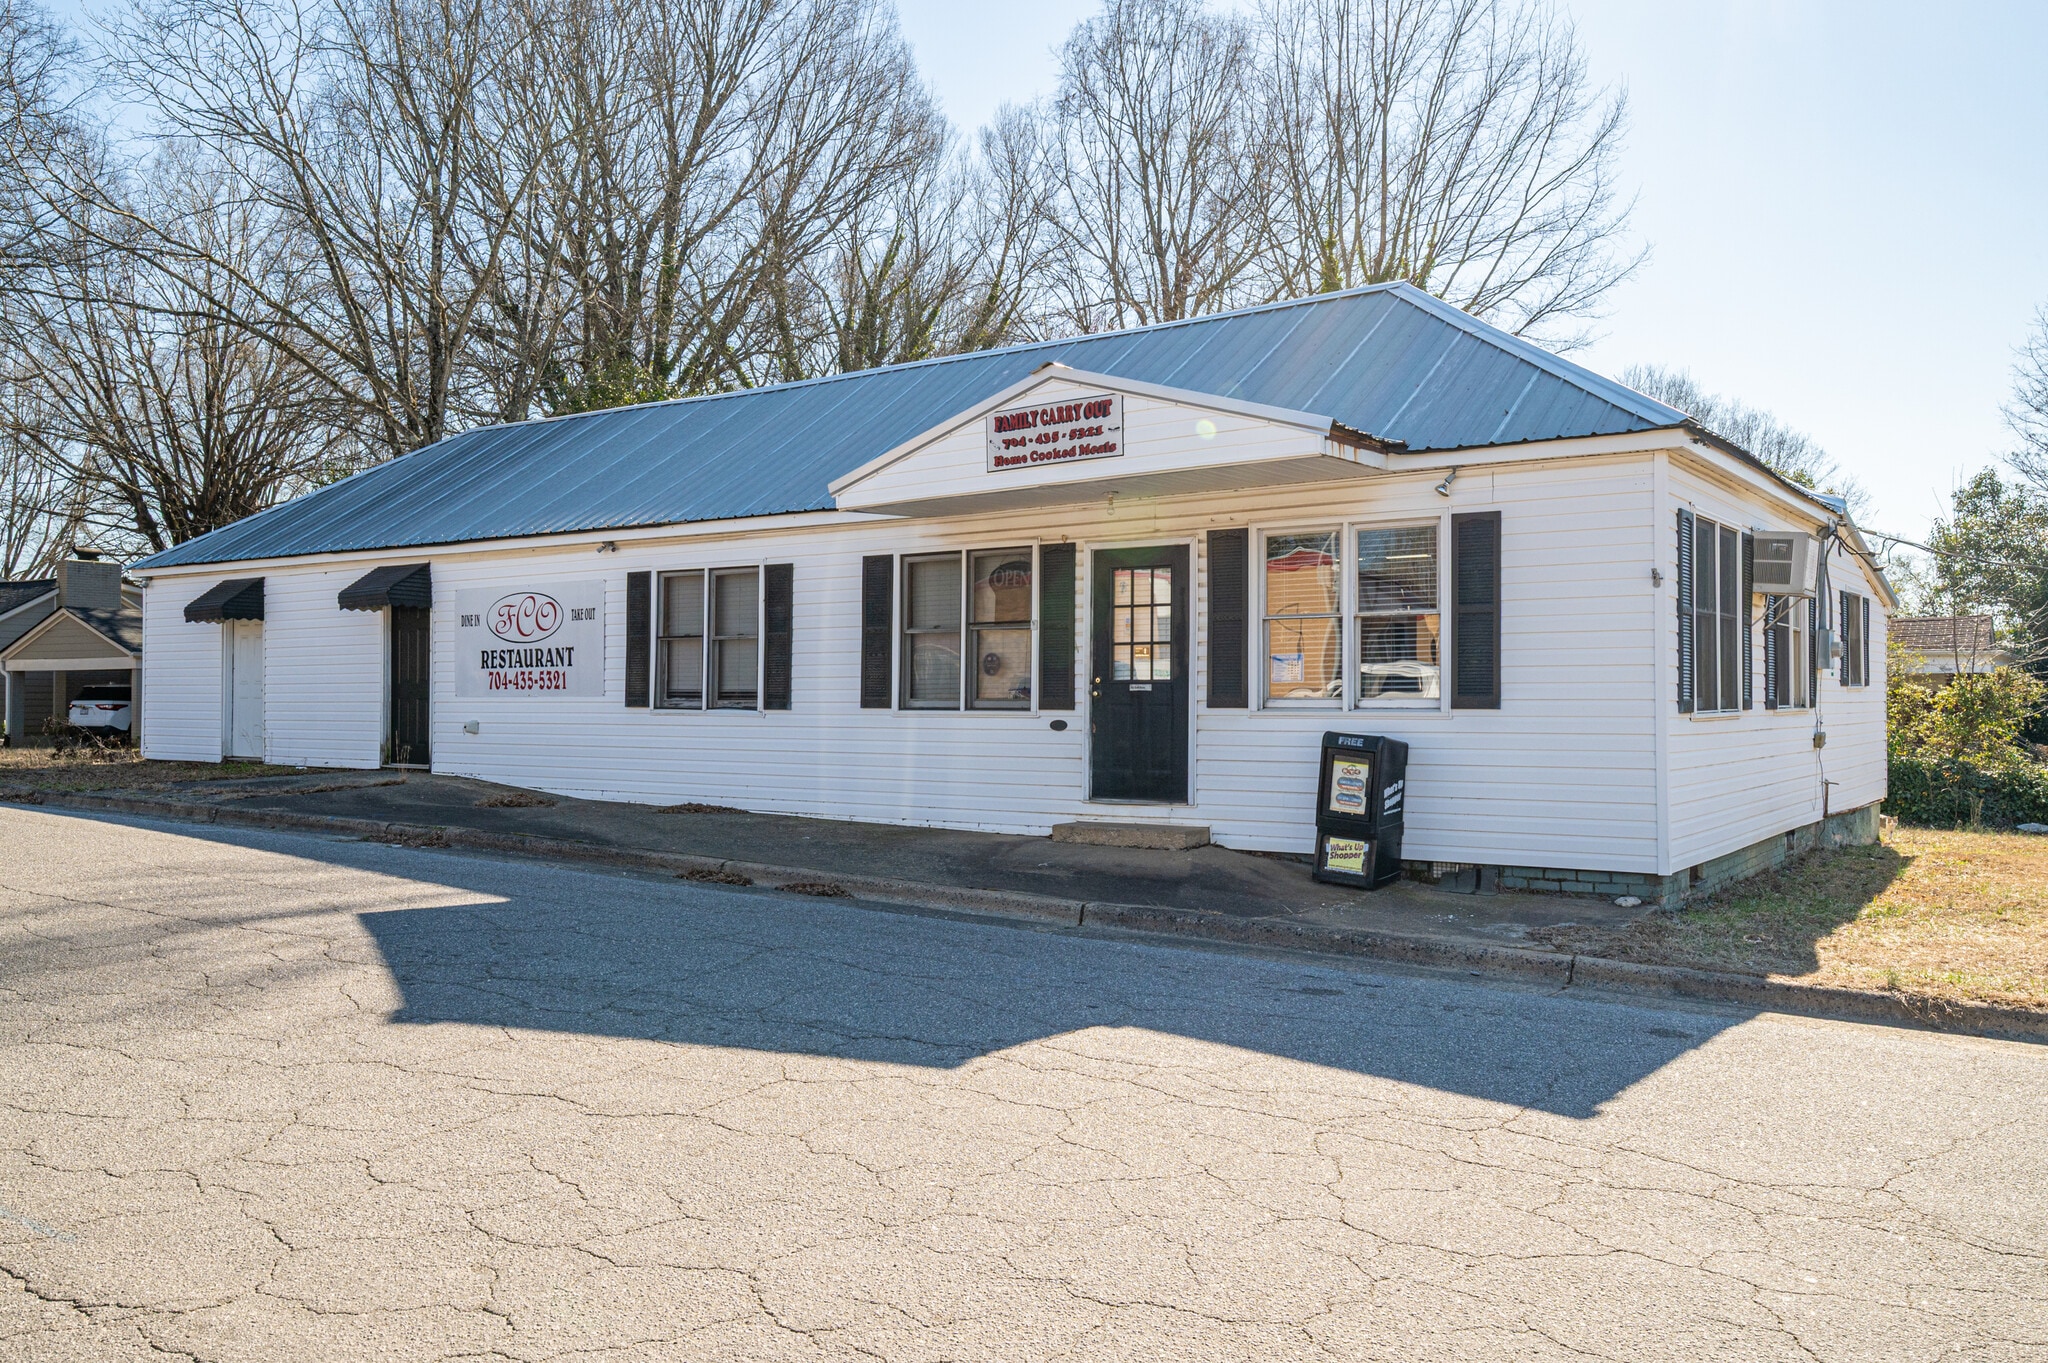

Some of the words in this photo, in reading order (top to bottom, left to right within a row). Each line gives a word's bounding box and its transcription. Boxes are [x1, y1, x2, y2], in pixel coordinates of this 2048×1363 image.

[994, 410, 1039, 433] FAMILY
[1040, 403, 1083, 426] CARRY
[1084, 399, 1113, 420] OUT
[994, 455, 1028, 467] Home
[1030, 445, 1077, 462] Cooked
[1079, 441, 1117, 456] Meals
[993, 569, 1032, 587] OPEN
[461, 614, 474, 627] DINE
[474, 614, 481, 627] IN
[495, 595, 557, 637] FCO
[571, 608, 584, 621] TAKE
[584, 607, 596, 620] OUT
[481, 646, 575, 669] RESTAURANT
[488, 670, 567, 690] 704-435-5321
[1338, 736, 1364, 747] FREE
[1329, 851, 1363, 860] Shopper
[1330, 843, 1353, 852] What's
[1354, 842, 1364, 852] Up
